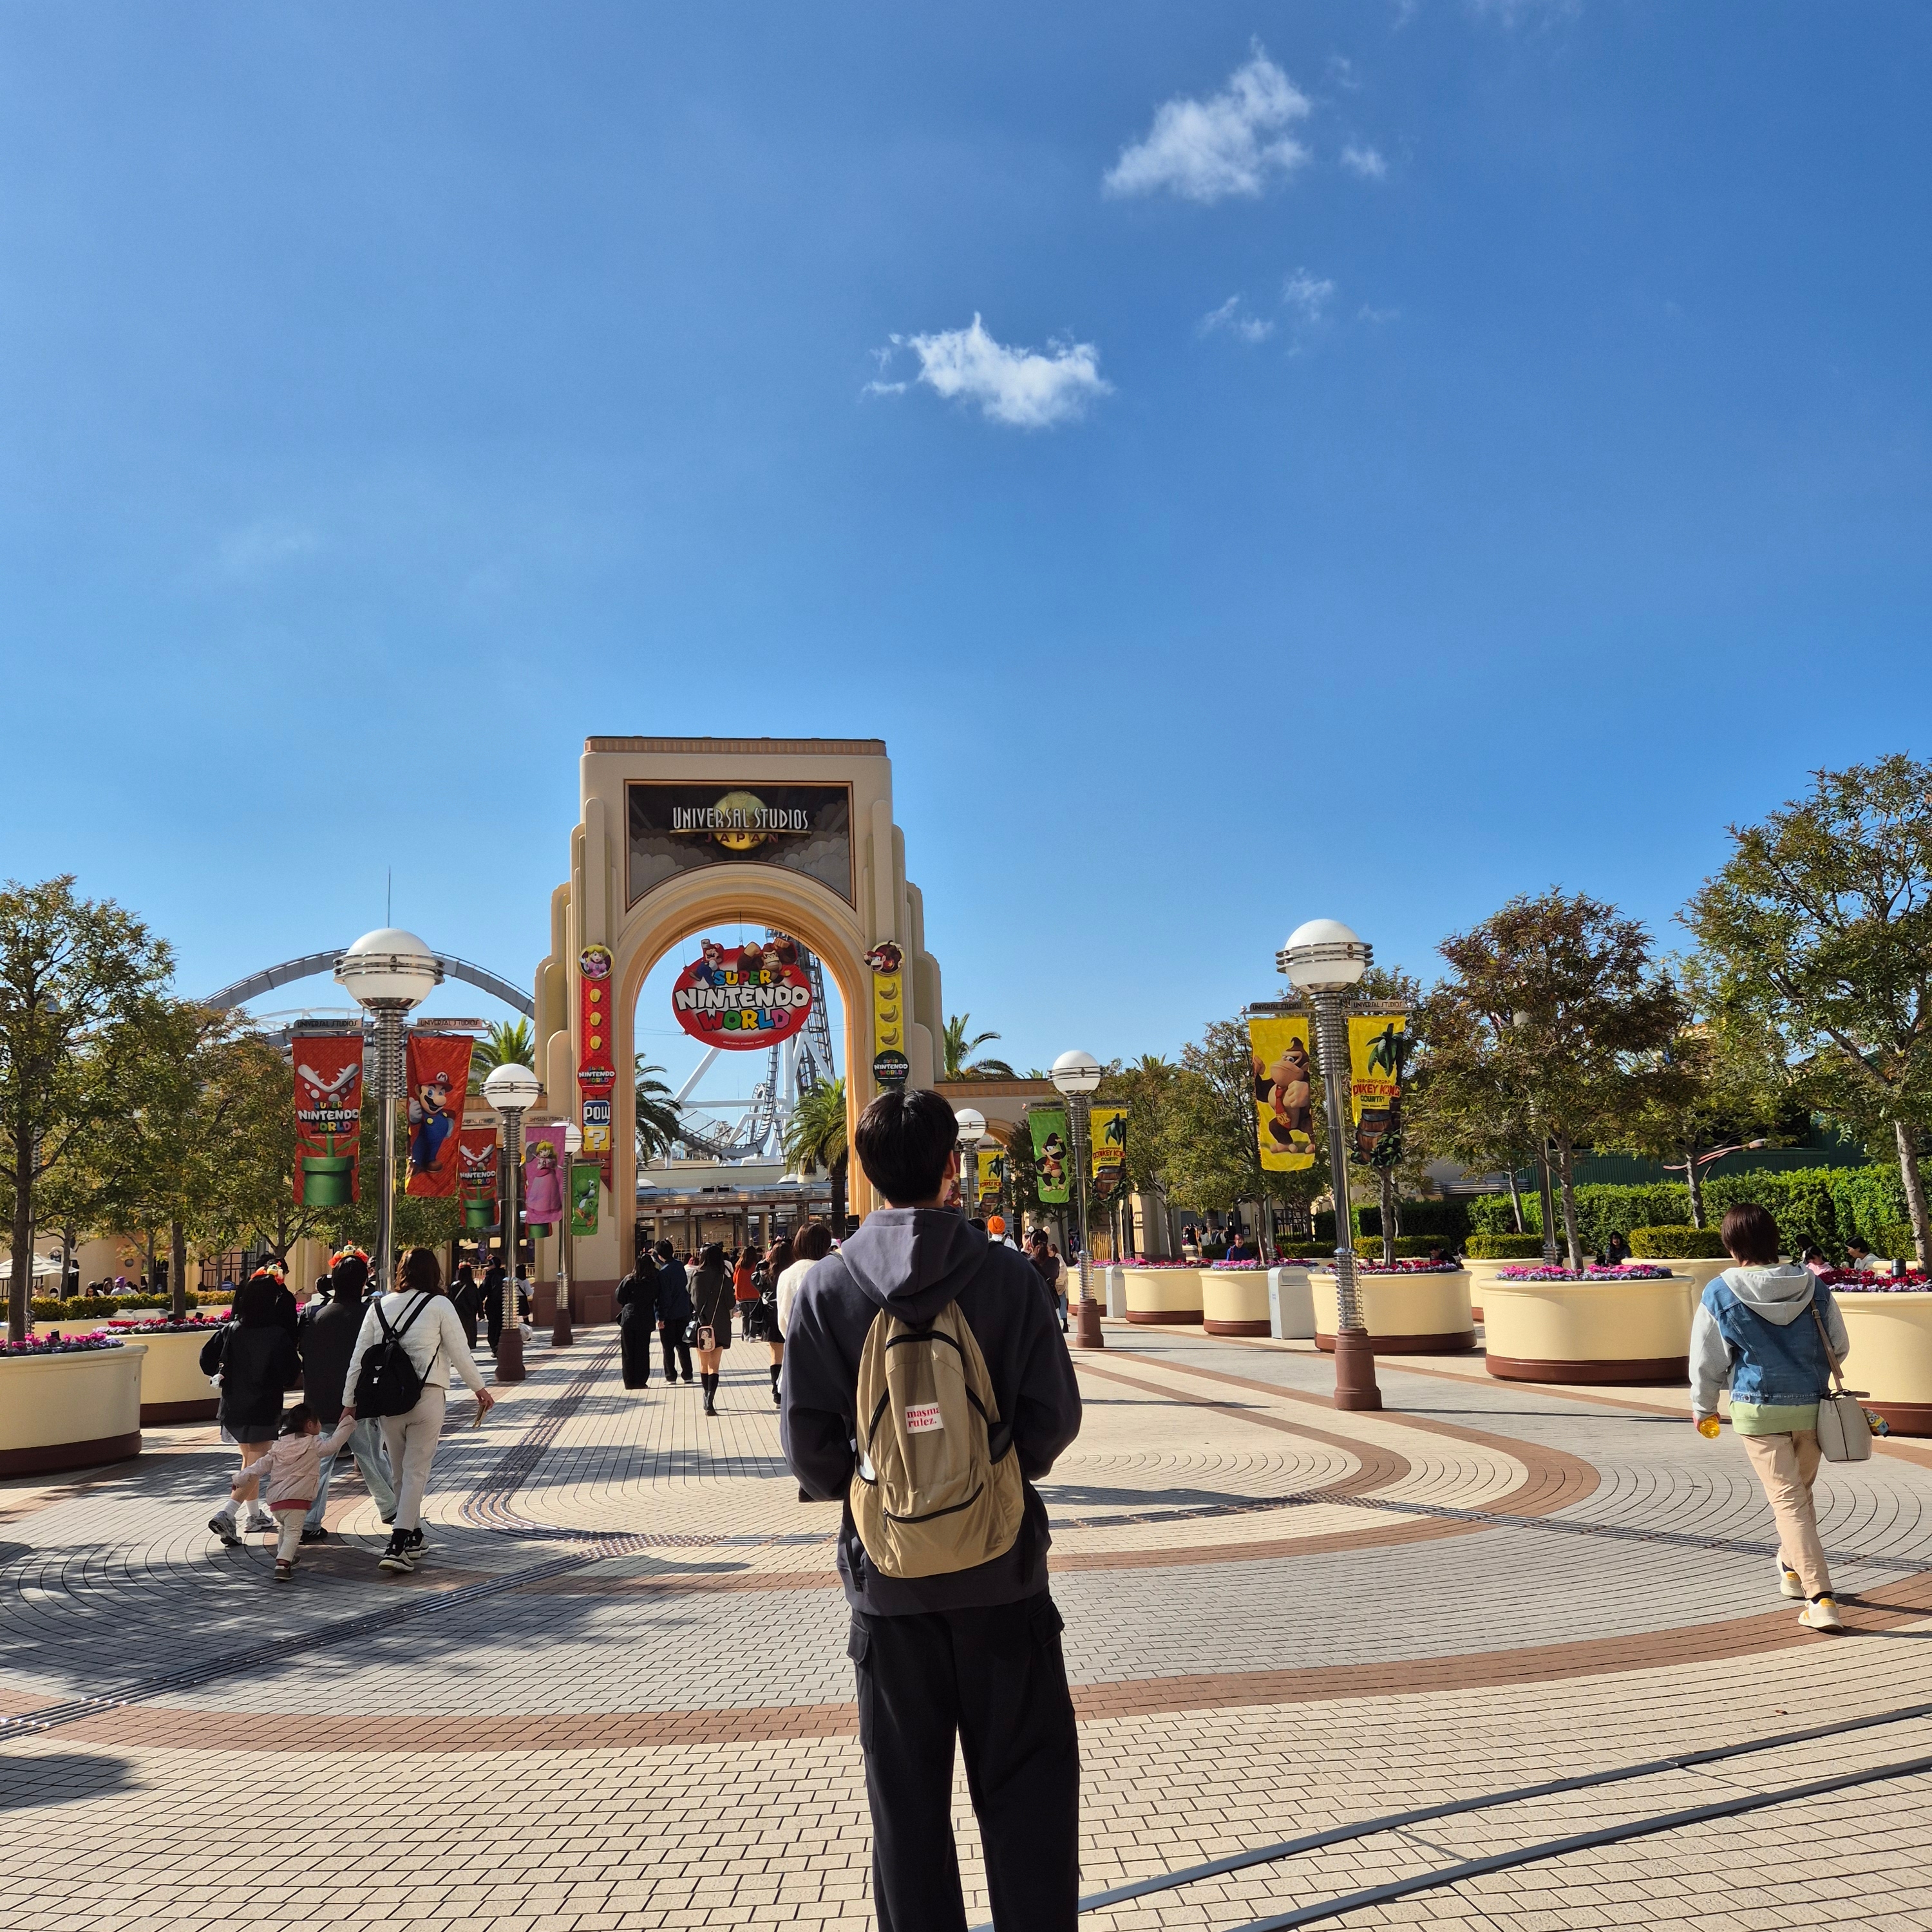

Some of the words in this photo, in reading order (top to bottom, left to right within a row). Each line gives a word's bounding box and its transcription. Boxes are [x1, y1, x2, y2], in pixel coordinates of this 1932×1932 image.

[673, 807, 750, 829] UNIVERSAL
[754, 807, 808, 829] STUDIOS
[705, 833, 779, 843] JAPAN
[713, 969, 772, 986] SUPER
[674, 986, 811, 1010] NINTENDO
[696, 1008, 791, 1030] WORLD
[1380, 1084, 1401, 1097] KONG
[314, 1101, 343, 1109] SUPER
[298, 1108, 359, 1121] NINTENDO
[583, 1106, 611, 1121] POW
[459, 1170, 496, 1179] NINTENDO
[908, 1418, 937, 1428] rulez.
